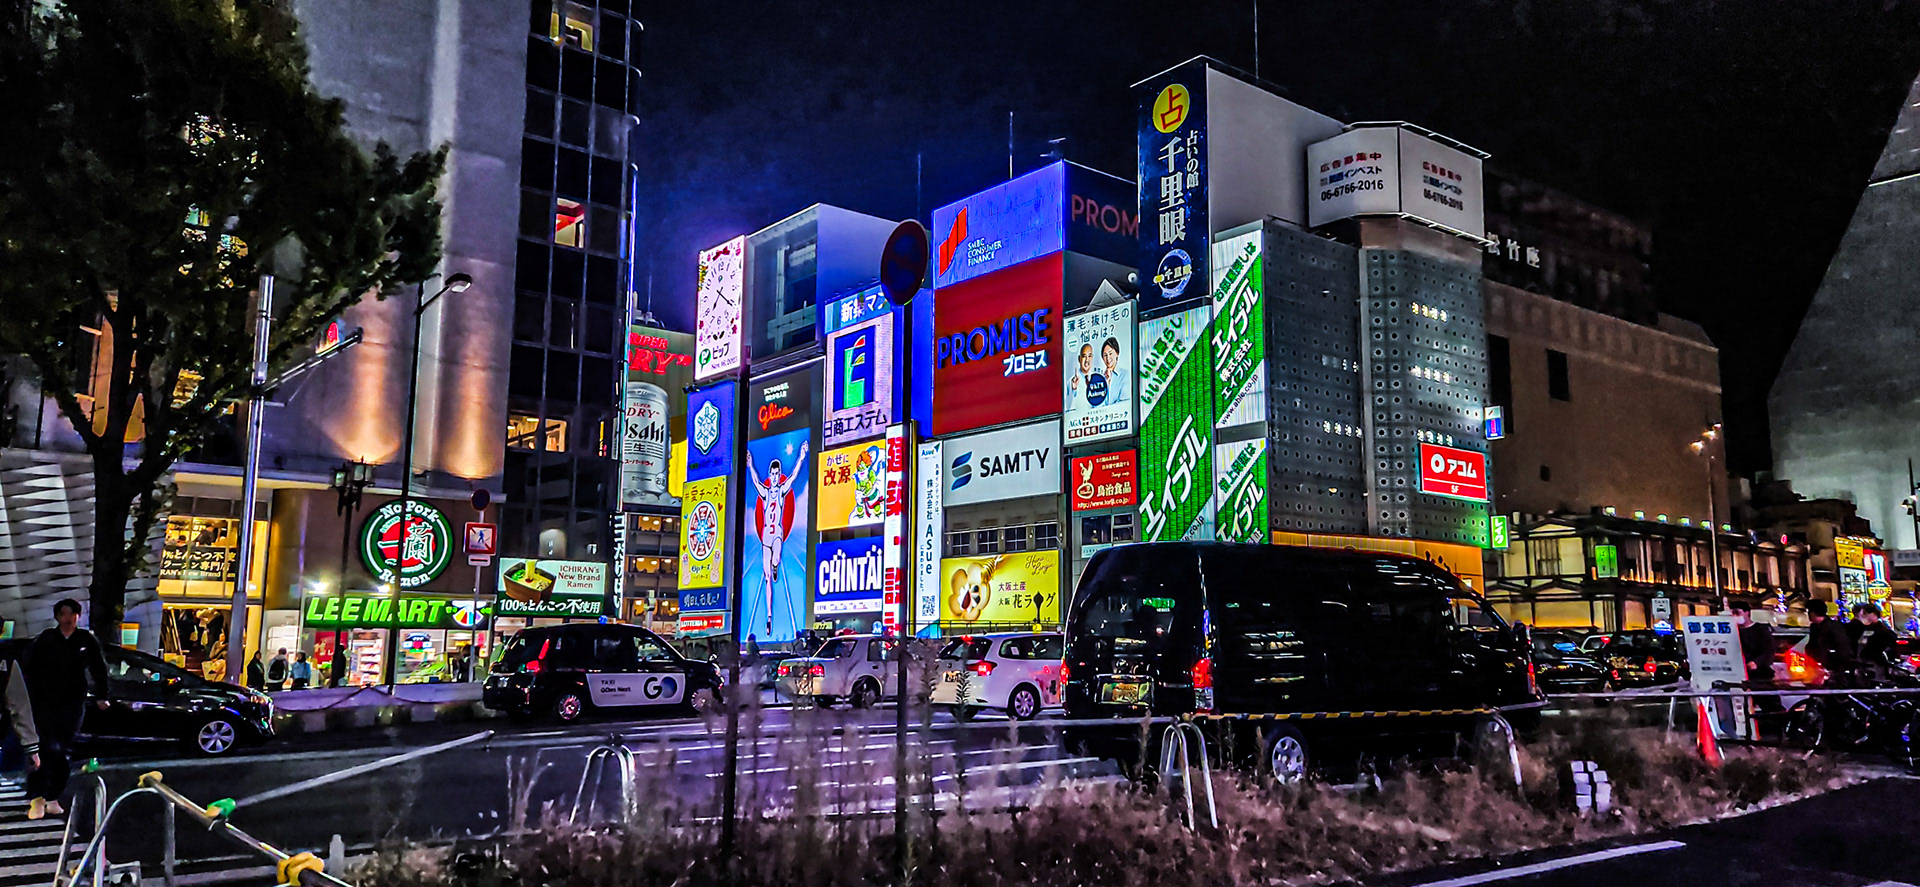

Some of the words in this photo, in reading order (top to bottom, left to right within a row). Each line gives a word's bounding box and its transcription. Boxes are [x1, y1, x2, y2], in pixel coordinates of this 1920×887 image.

[1160, 88, 1183, 130] 占
[1187, 130, 1199, 190] 占いの館
[1158, 137, 1186, 246] 千里眼
[1321, 179, 1383, 201] 06-6766-2016
[967, 241, 1002, 258] CONSUMER
[968, 238, 985, 250] SMBC
[967, 252, 995, 267] FINANCE
[1067, 308, 1129, 333] 薄毛・抜け毛の
[1212, 278, 1260, 371] エイブル
[937, 308, 1048, 369] PROMISE
[1003, 350, 1047, 377] プロミス
[1141, 339, 1187, 404] いい部屋で
[1219, 338, 1252, 383] 株式会社
[1221, 357, 1252, 400] エイブル
[758, 402, 794, 430] Glico
[824, 408, 887, 438] 日商エステム
[633, 443, 645, 453] 生
[980, 448, 1050, 477] SAMTY
[1446, 458, 1477, 479] アコム
[824, 465, 851, 487] 改源
[1139, 416, 1208, 540] エイブル
[380, 504, 402, 520] No
[406, 500, 438, 523] Pork
[1494, 518, 1503, 544] レイク
[925, 523, 934, 575] Asue
[558, 572, 575, 580] New
[577, 573, 600, 581] Brand
[559, 565, 599, 574] ICHIRAN's
[819, 545, 883, 595] CHINTAI
[998, 581, 1026, 592] 大阪土産
[306, 597, 363, 621] LEE
[362, 599, 446, 623] MART
[500, 598, 601, 614] 100%とんこつ不使用
[1013, 592, 1056, 609] 花ラグ
[643, 676, 678, 700] GO
